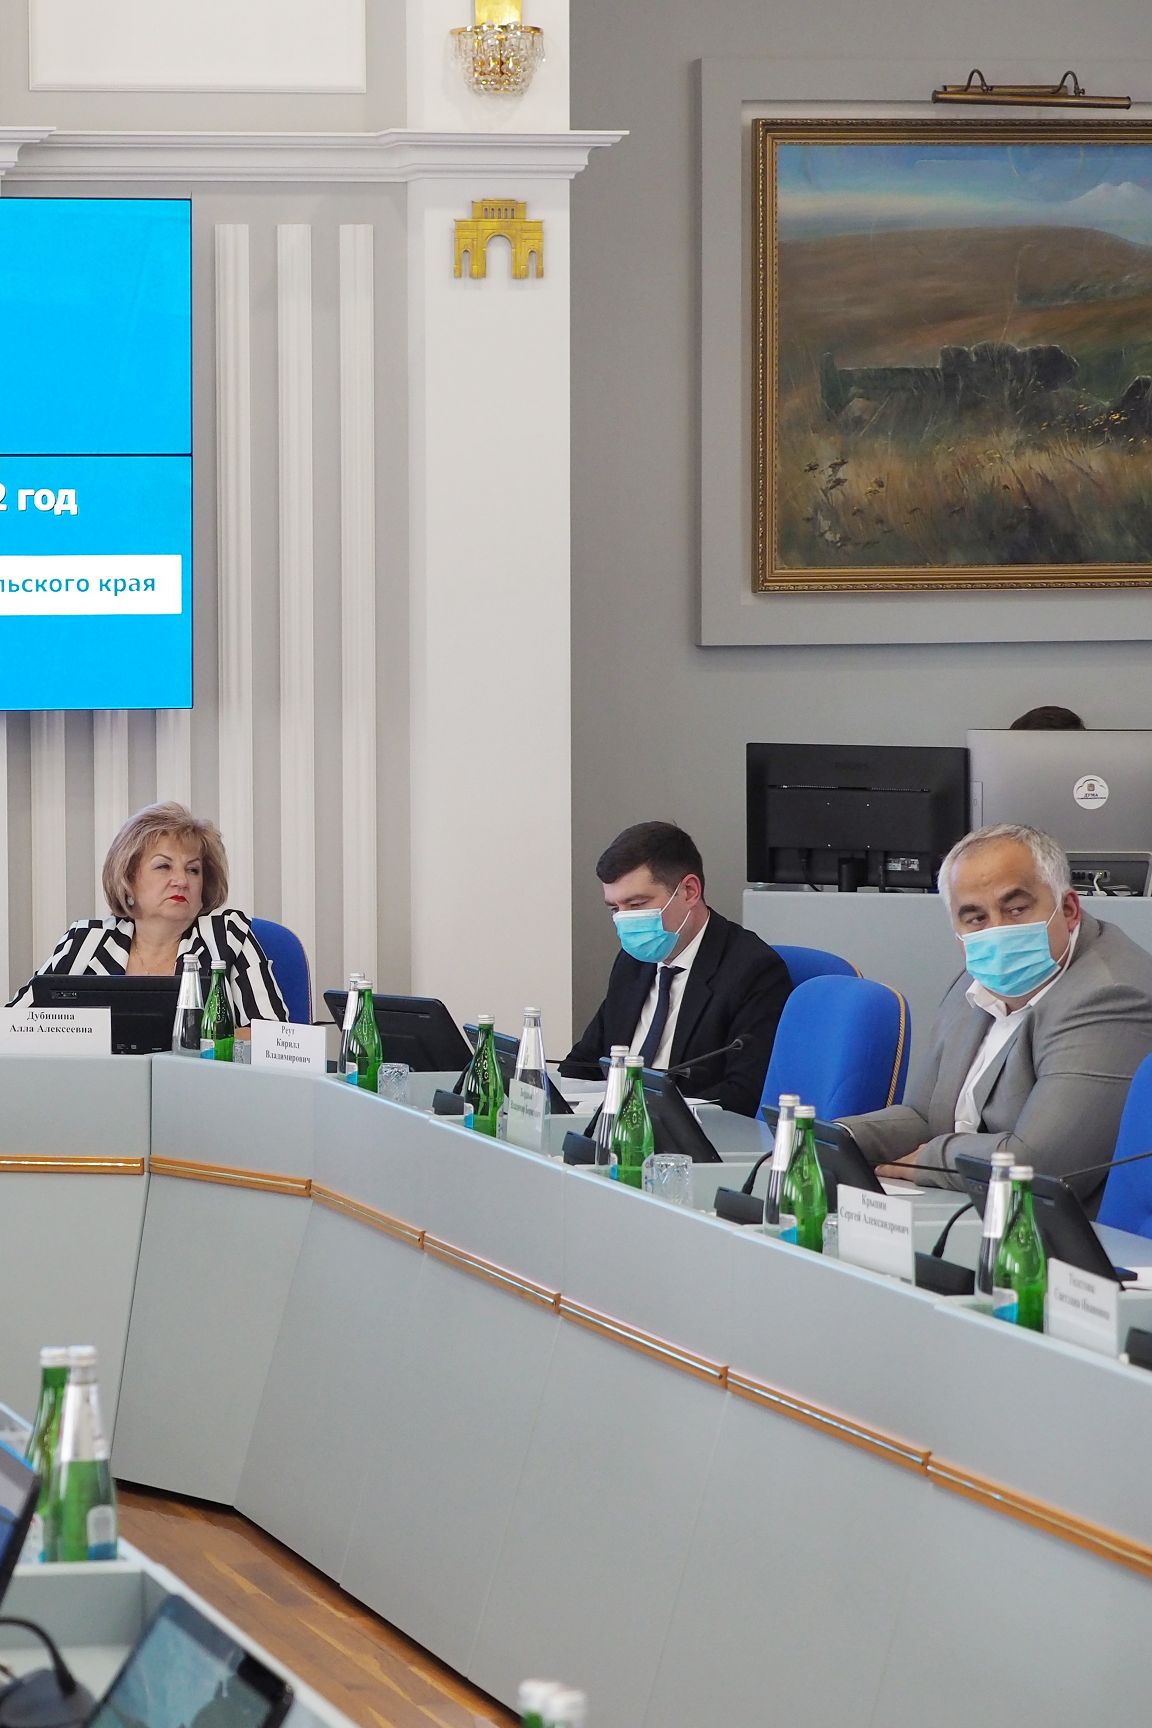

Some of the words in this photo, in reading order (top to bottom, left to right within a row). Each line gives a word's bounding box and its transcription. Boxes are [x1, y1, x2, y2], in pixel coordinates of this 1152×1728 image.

[17, 488, 78, 516] год
[99, 576, 156, 593] края
[26, 1011, 76, 1022] Дубинина
[9, 1024, 35, 1033] Алла
[36, 1025, 94, 1034] Алексеевна
[265, 1050, 311, 1063] Владимирович
